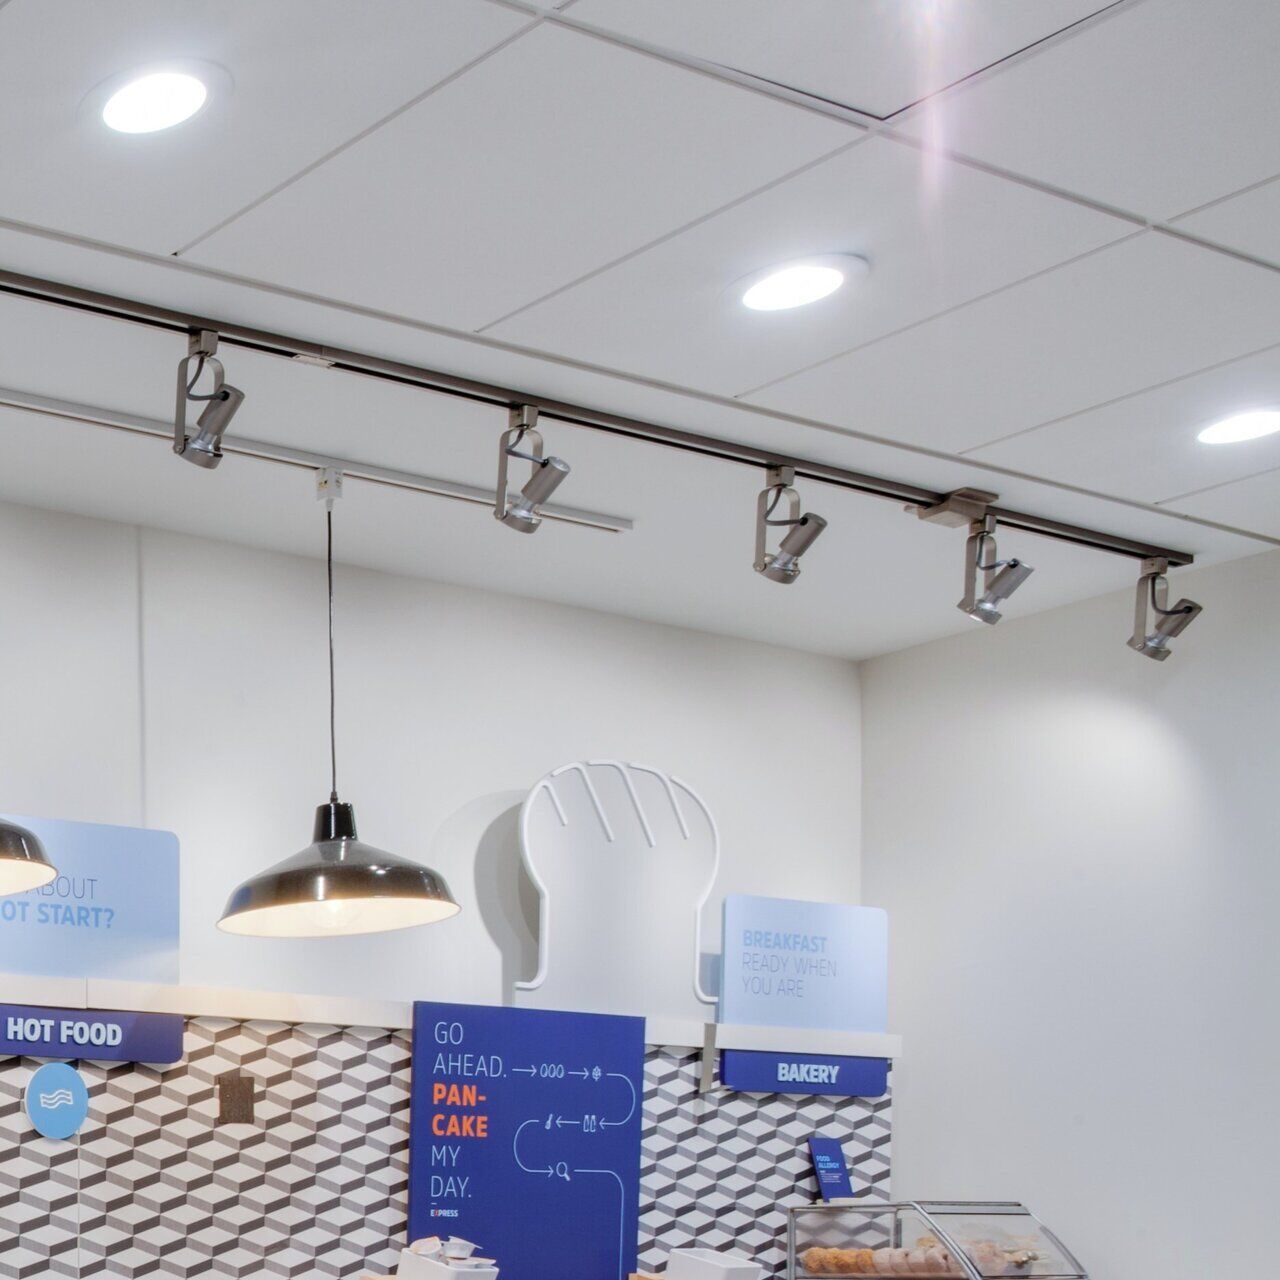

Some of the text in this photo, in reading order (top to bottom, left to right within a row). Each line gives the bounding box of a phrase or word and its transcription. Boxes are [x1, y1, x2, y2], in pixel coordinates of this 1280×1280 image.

[26, 876, 98, 900] BOUT
[37, 902, 115, 929] START?
[743, 930, 828, 953] BREAKFAST
[742, 952, 838, 978] READY WHEN
[742, 976, 805, 998] YOU ARE
[7, 1016, 122, 1046] HOT FOOD
[434, 1021, 464, 1045] GO
[432, 1053, 507, 1079] AHEAD.
[777, 1062, 839, 1084] BAKERY
[433, 1083, 487, 1106] PAN-
[432, 1113, 488, 1138] CAKE
[431, 1145, 460, 1167] MY
[430, 1175, 472, 1198] DAY.
[430, 1209, 459, 1218] EXPRESS
